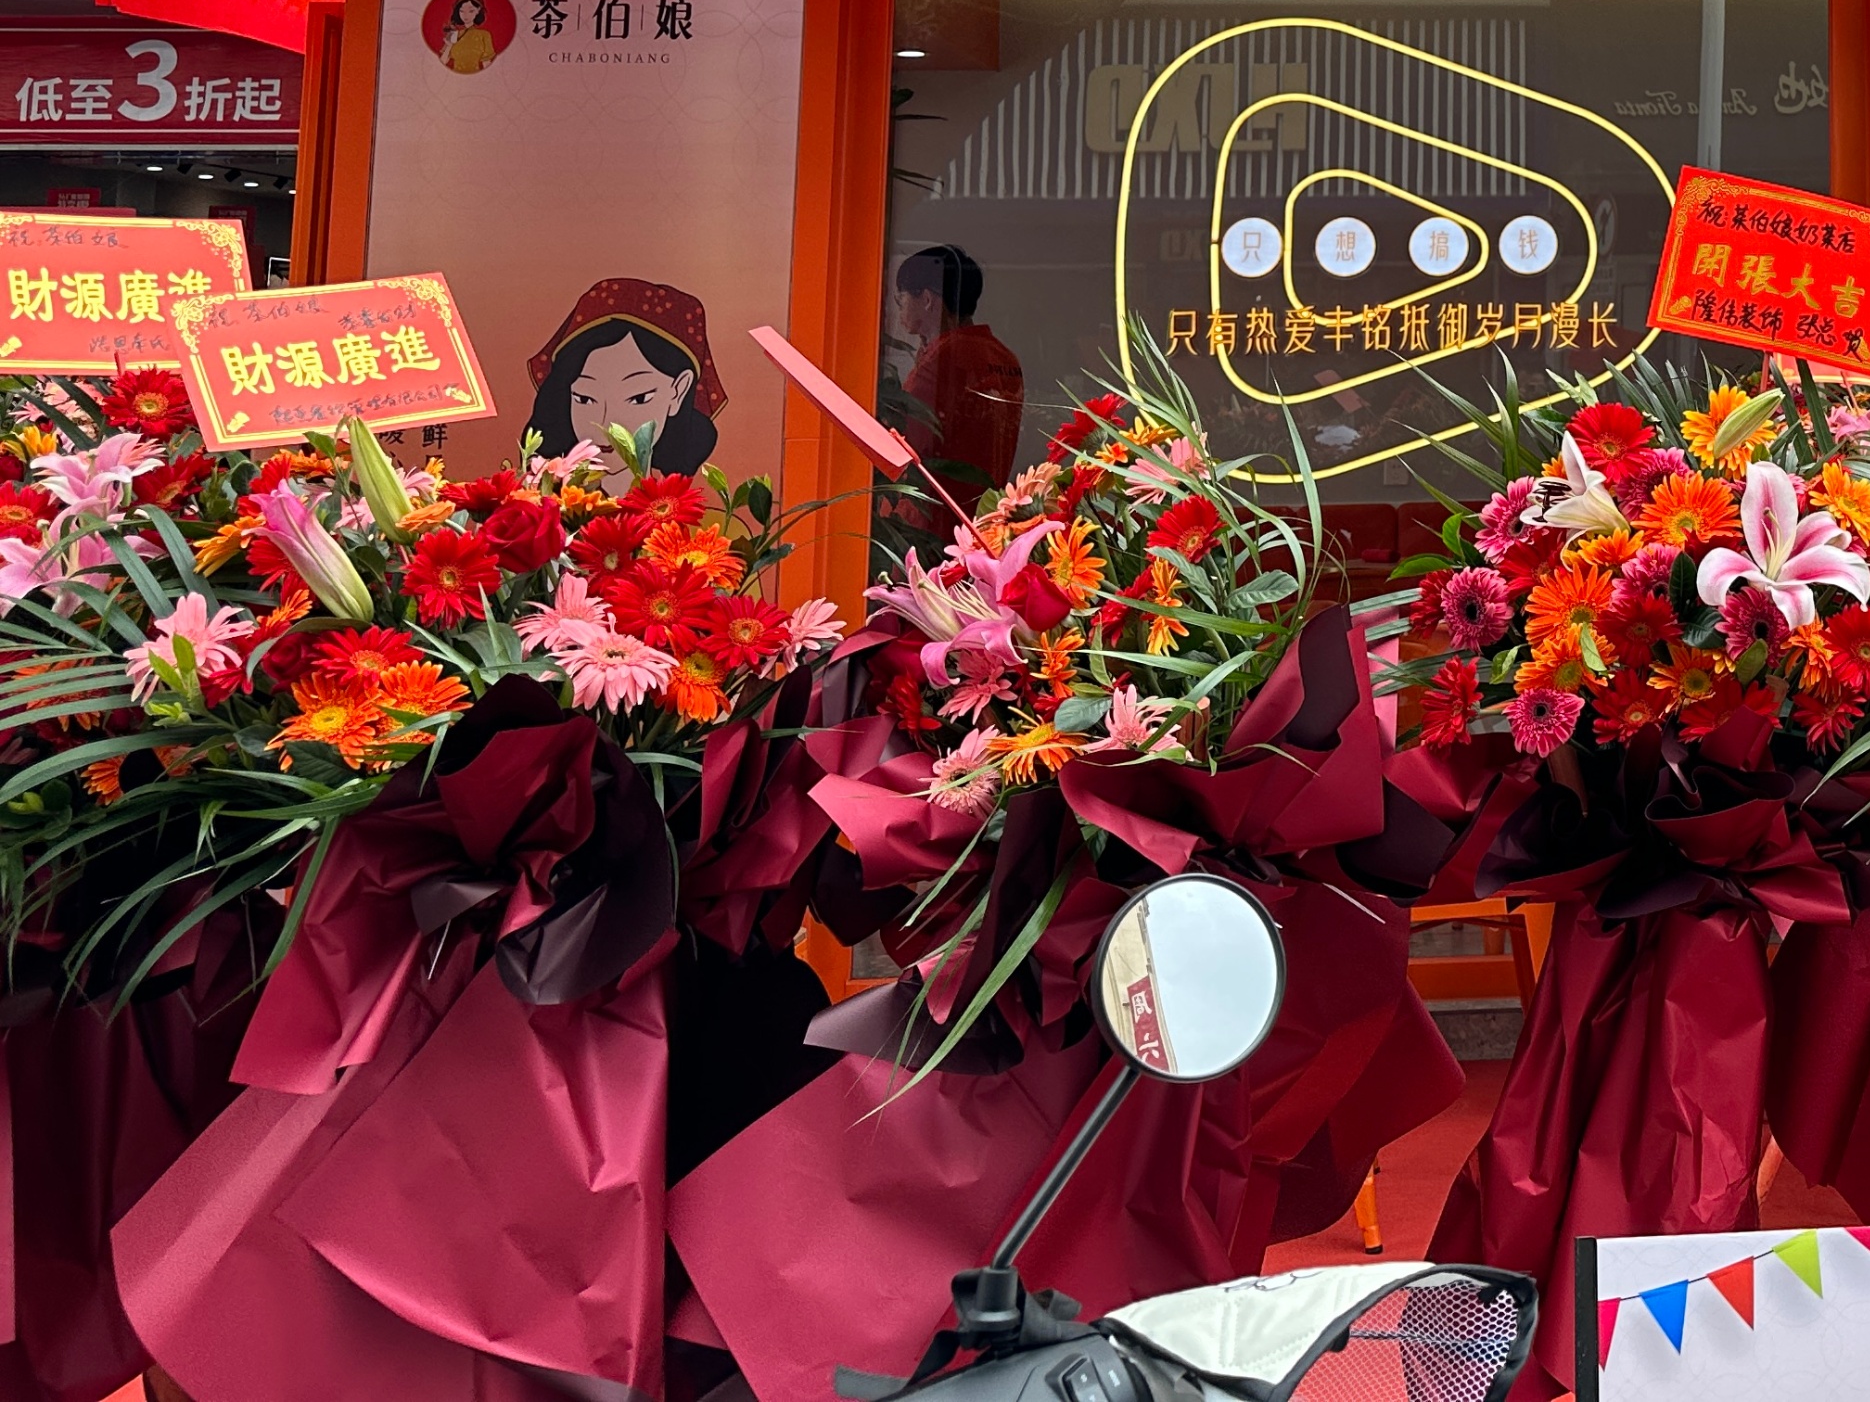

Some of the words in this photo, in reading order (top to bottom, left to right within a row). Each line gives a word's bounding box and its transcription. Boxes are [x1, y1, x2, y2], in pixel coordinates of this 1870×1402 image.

[15, 38, 284, 125] 低至3折起
[547, 51, 672, 66] CHABONIANG
[1240, 228, 1540, 264] 只想搞钱
[1692, 243, 1866, 319] 開張大吉
[220, 325, 441, 396] 財源廣進
